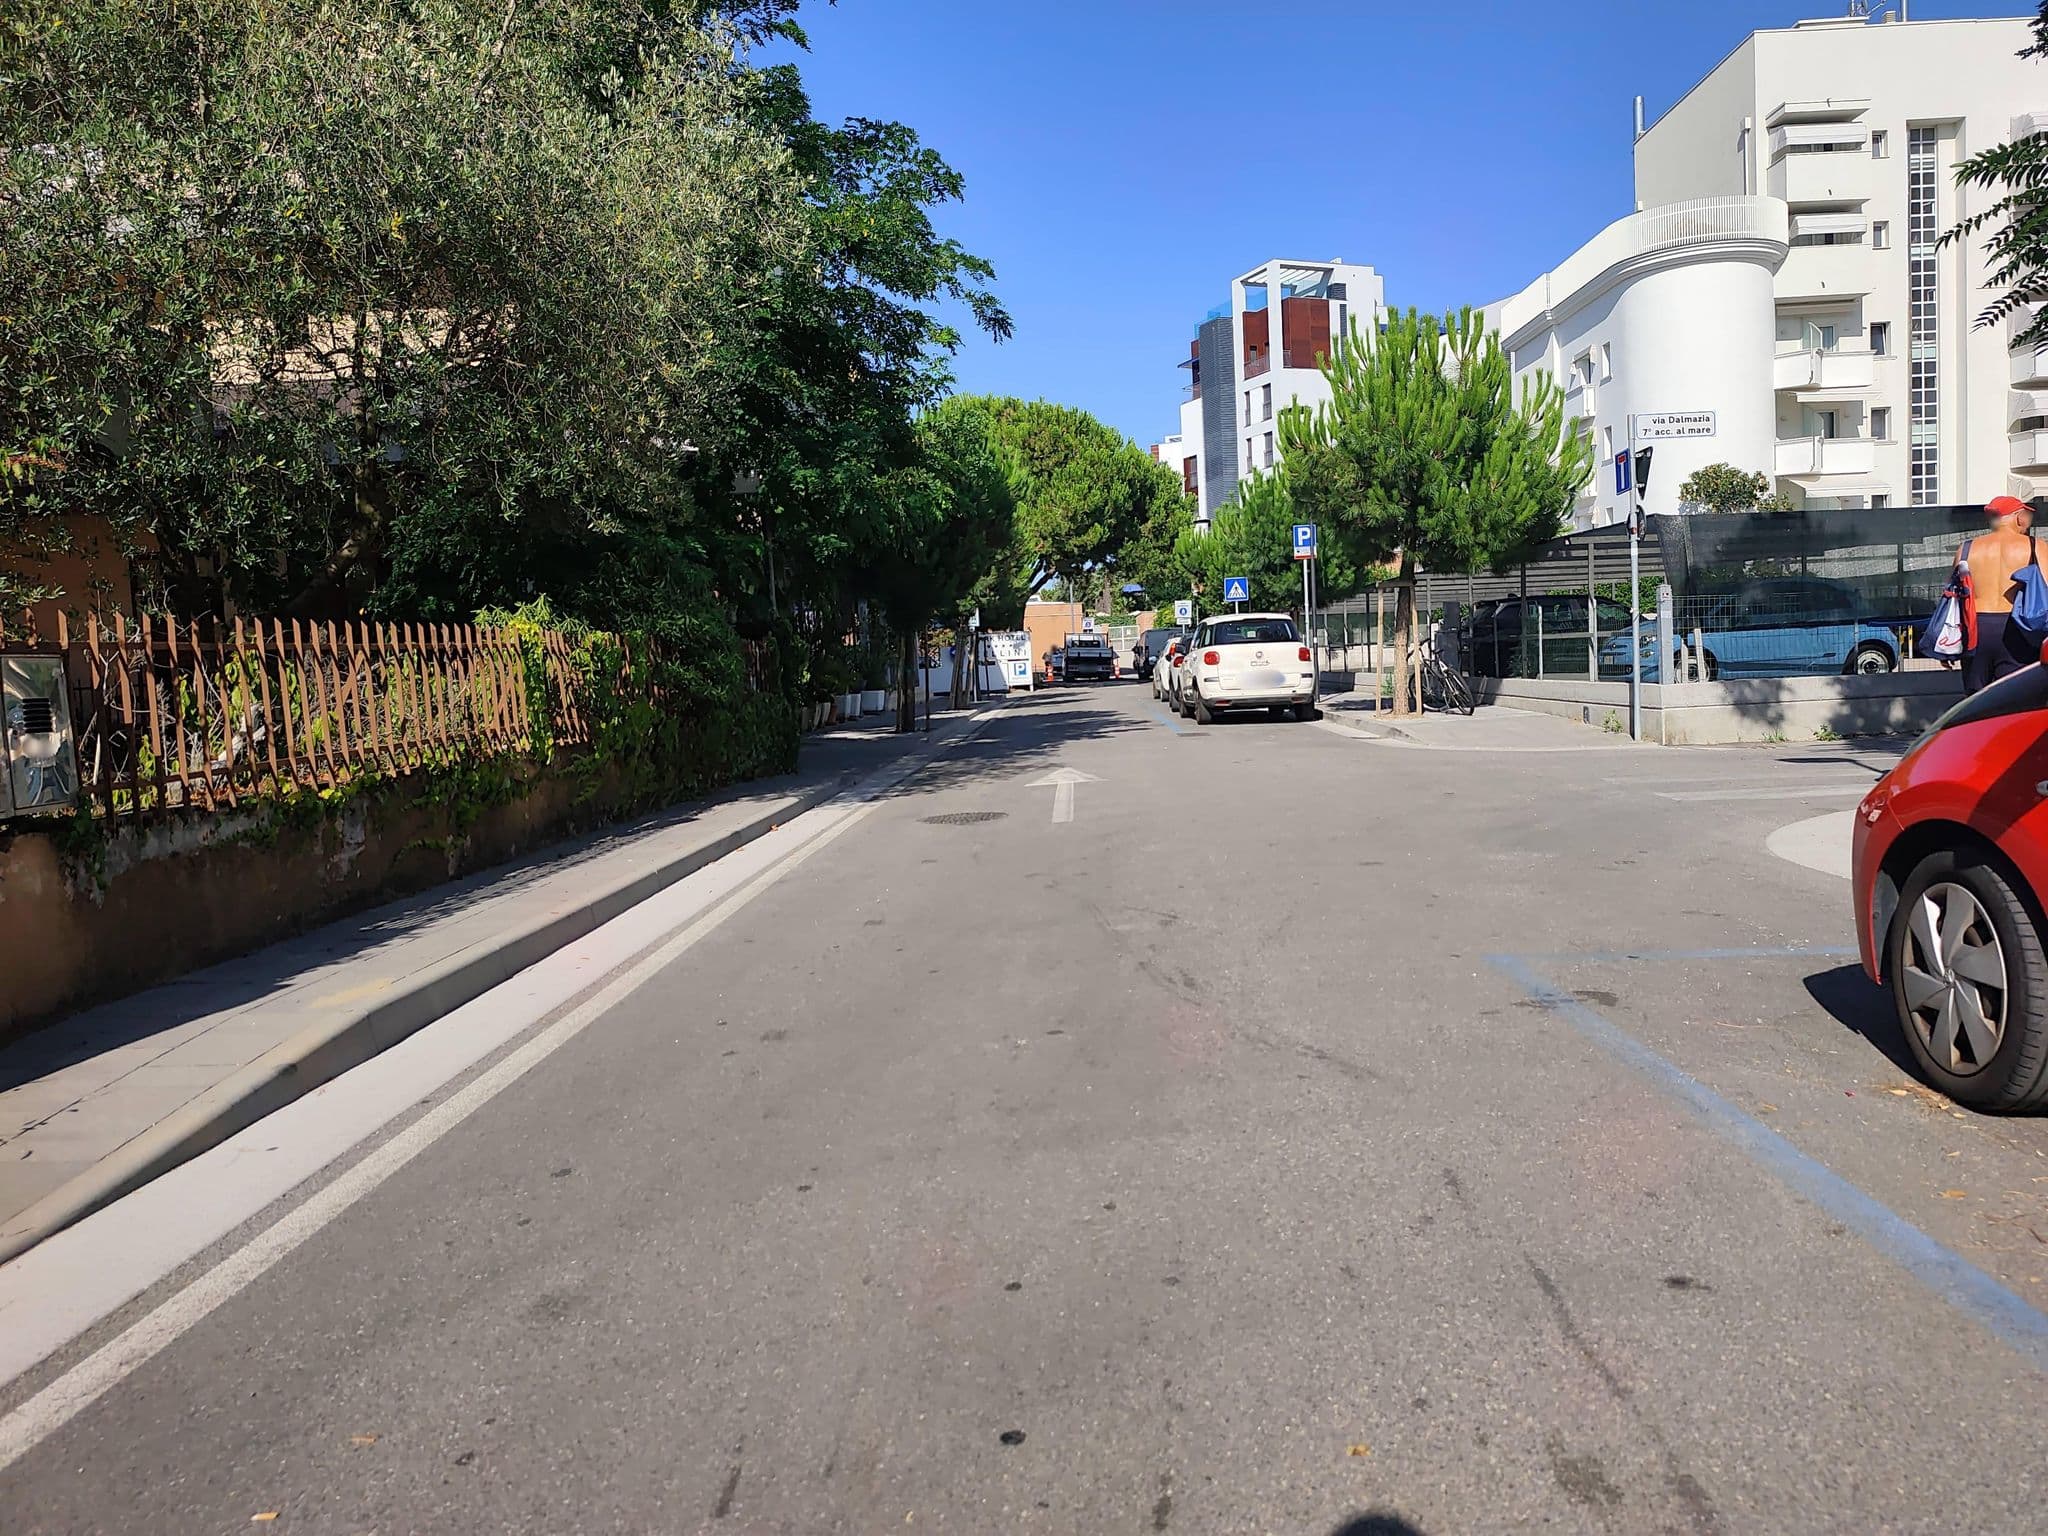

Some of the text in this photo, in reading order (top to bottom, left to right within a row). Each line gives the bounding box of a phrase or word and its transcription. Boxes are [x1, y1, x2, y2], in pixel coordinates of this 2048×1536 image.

[1652, 415, 1710, 424] via Dalmazia
[1676, 427, 1685, 435] al
[1298, 527, 1311, 546] P
[1015, 662, 1025, 675] P
